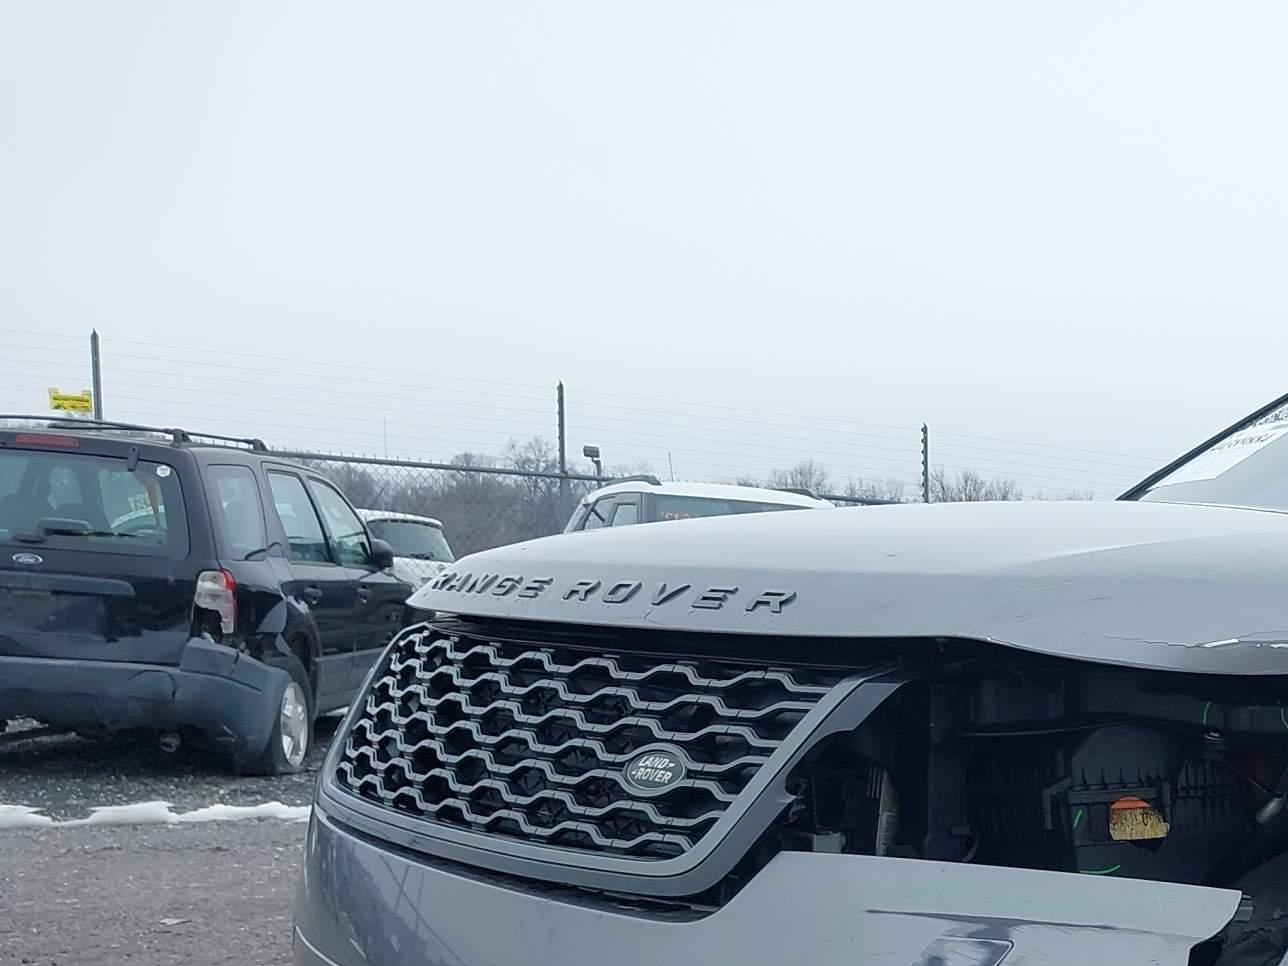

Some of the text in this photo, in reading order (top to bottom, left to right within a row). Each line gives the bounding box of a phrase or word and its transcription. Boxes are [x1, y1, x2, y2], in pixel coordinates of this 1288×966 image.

[430, 572, 798, 614] RANGE ROVER
[638, 755, 670, 769] LAND
[634, 767, 673, 784] ROVER
